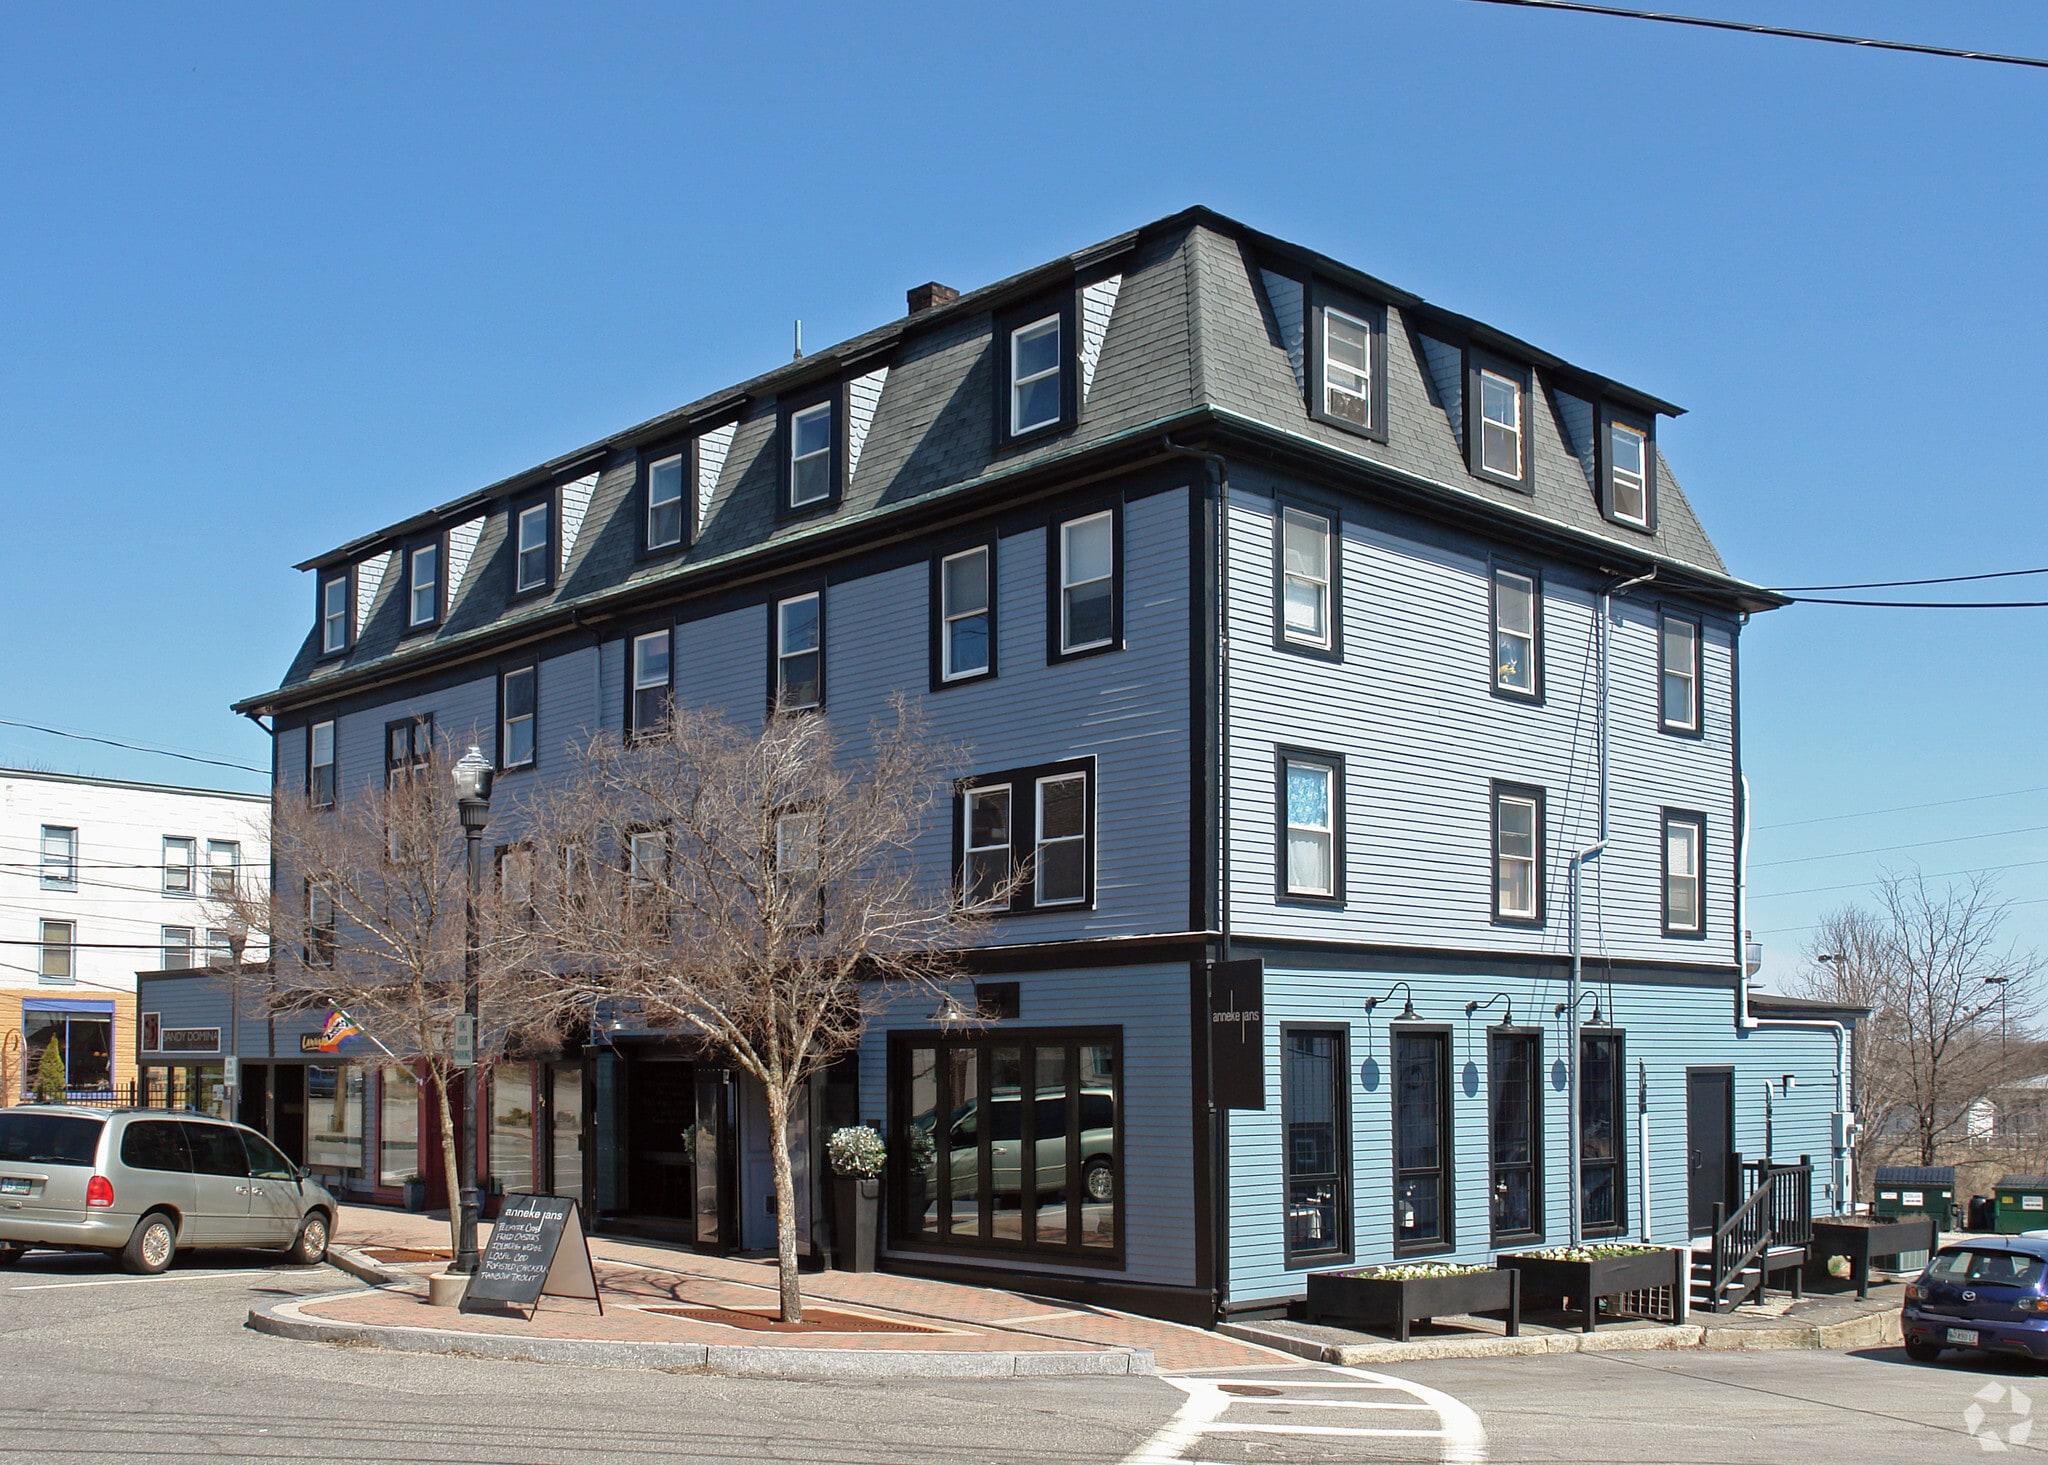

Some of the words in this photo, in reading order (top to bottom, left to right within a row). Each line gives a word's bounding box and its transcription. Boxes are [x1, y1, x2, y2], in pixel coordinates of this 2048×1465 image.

[1212, 990, 1240, 1022] anneke
[1242, 1010, 1260, 1044] jans
[505, 1200, 540, 1218] anneke
[538, 1212, 563, 1232] jans
[488, 1251, 511, 1260] LOCAL
